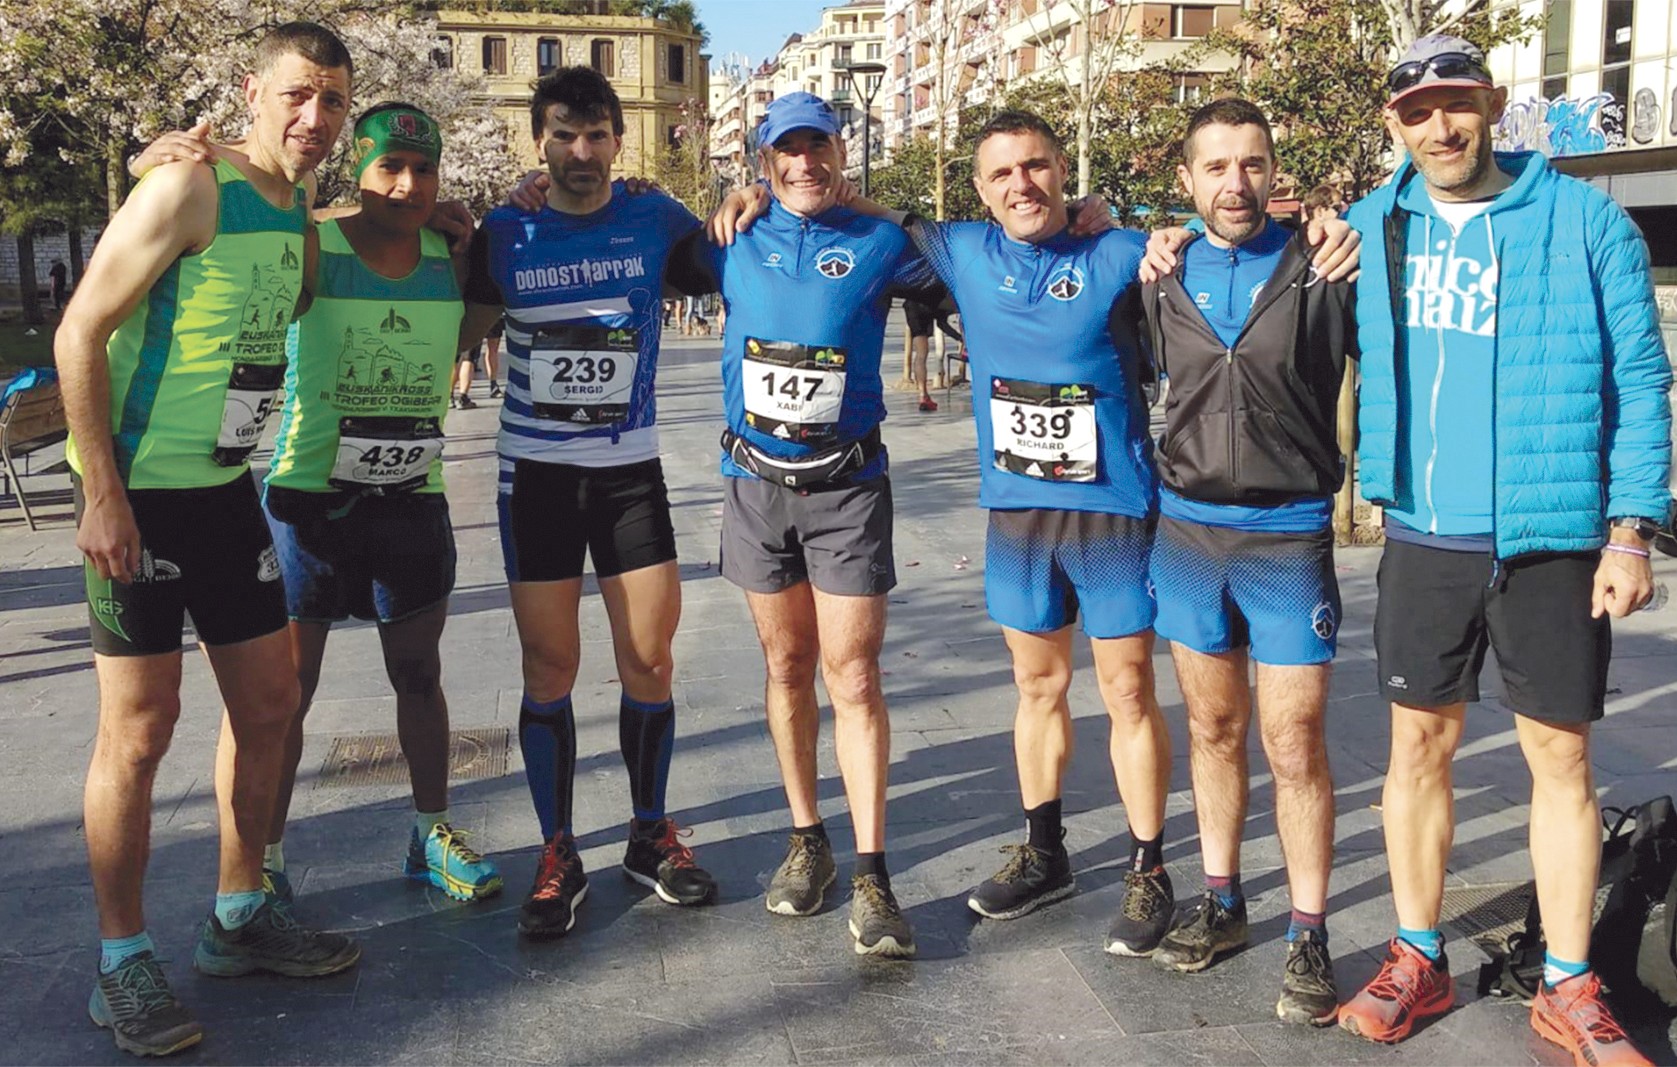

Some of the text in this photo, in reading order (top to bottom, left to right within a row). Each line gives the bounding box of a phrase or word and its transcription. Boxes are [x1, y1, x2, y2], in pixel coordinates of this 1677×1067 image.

[552, 356, 616, 384] 239
[334, 393, 388, 406] TROFEO
[762, 372, 824, 402] 147
[1010, 408, 1071, 440] 339
[359, 445, 425, 468] 438
[1017, 438, 1065, 450] RICHARD
